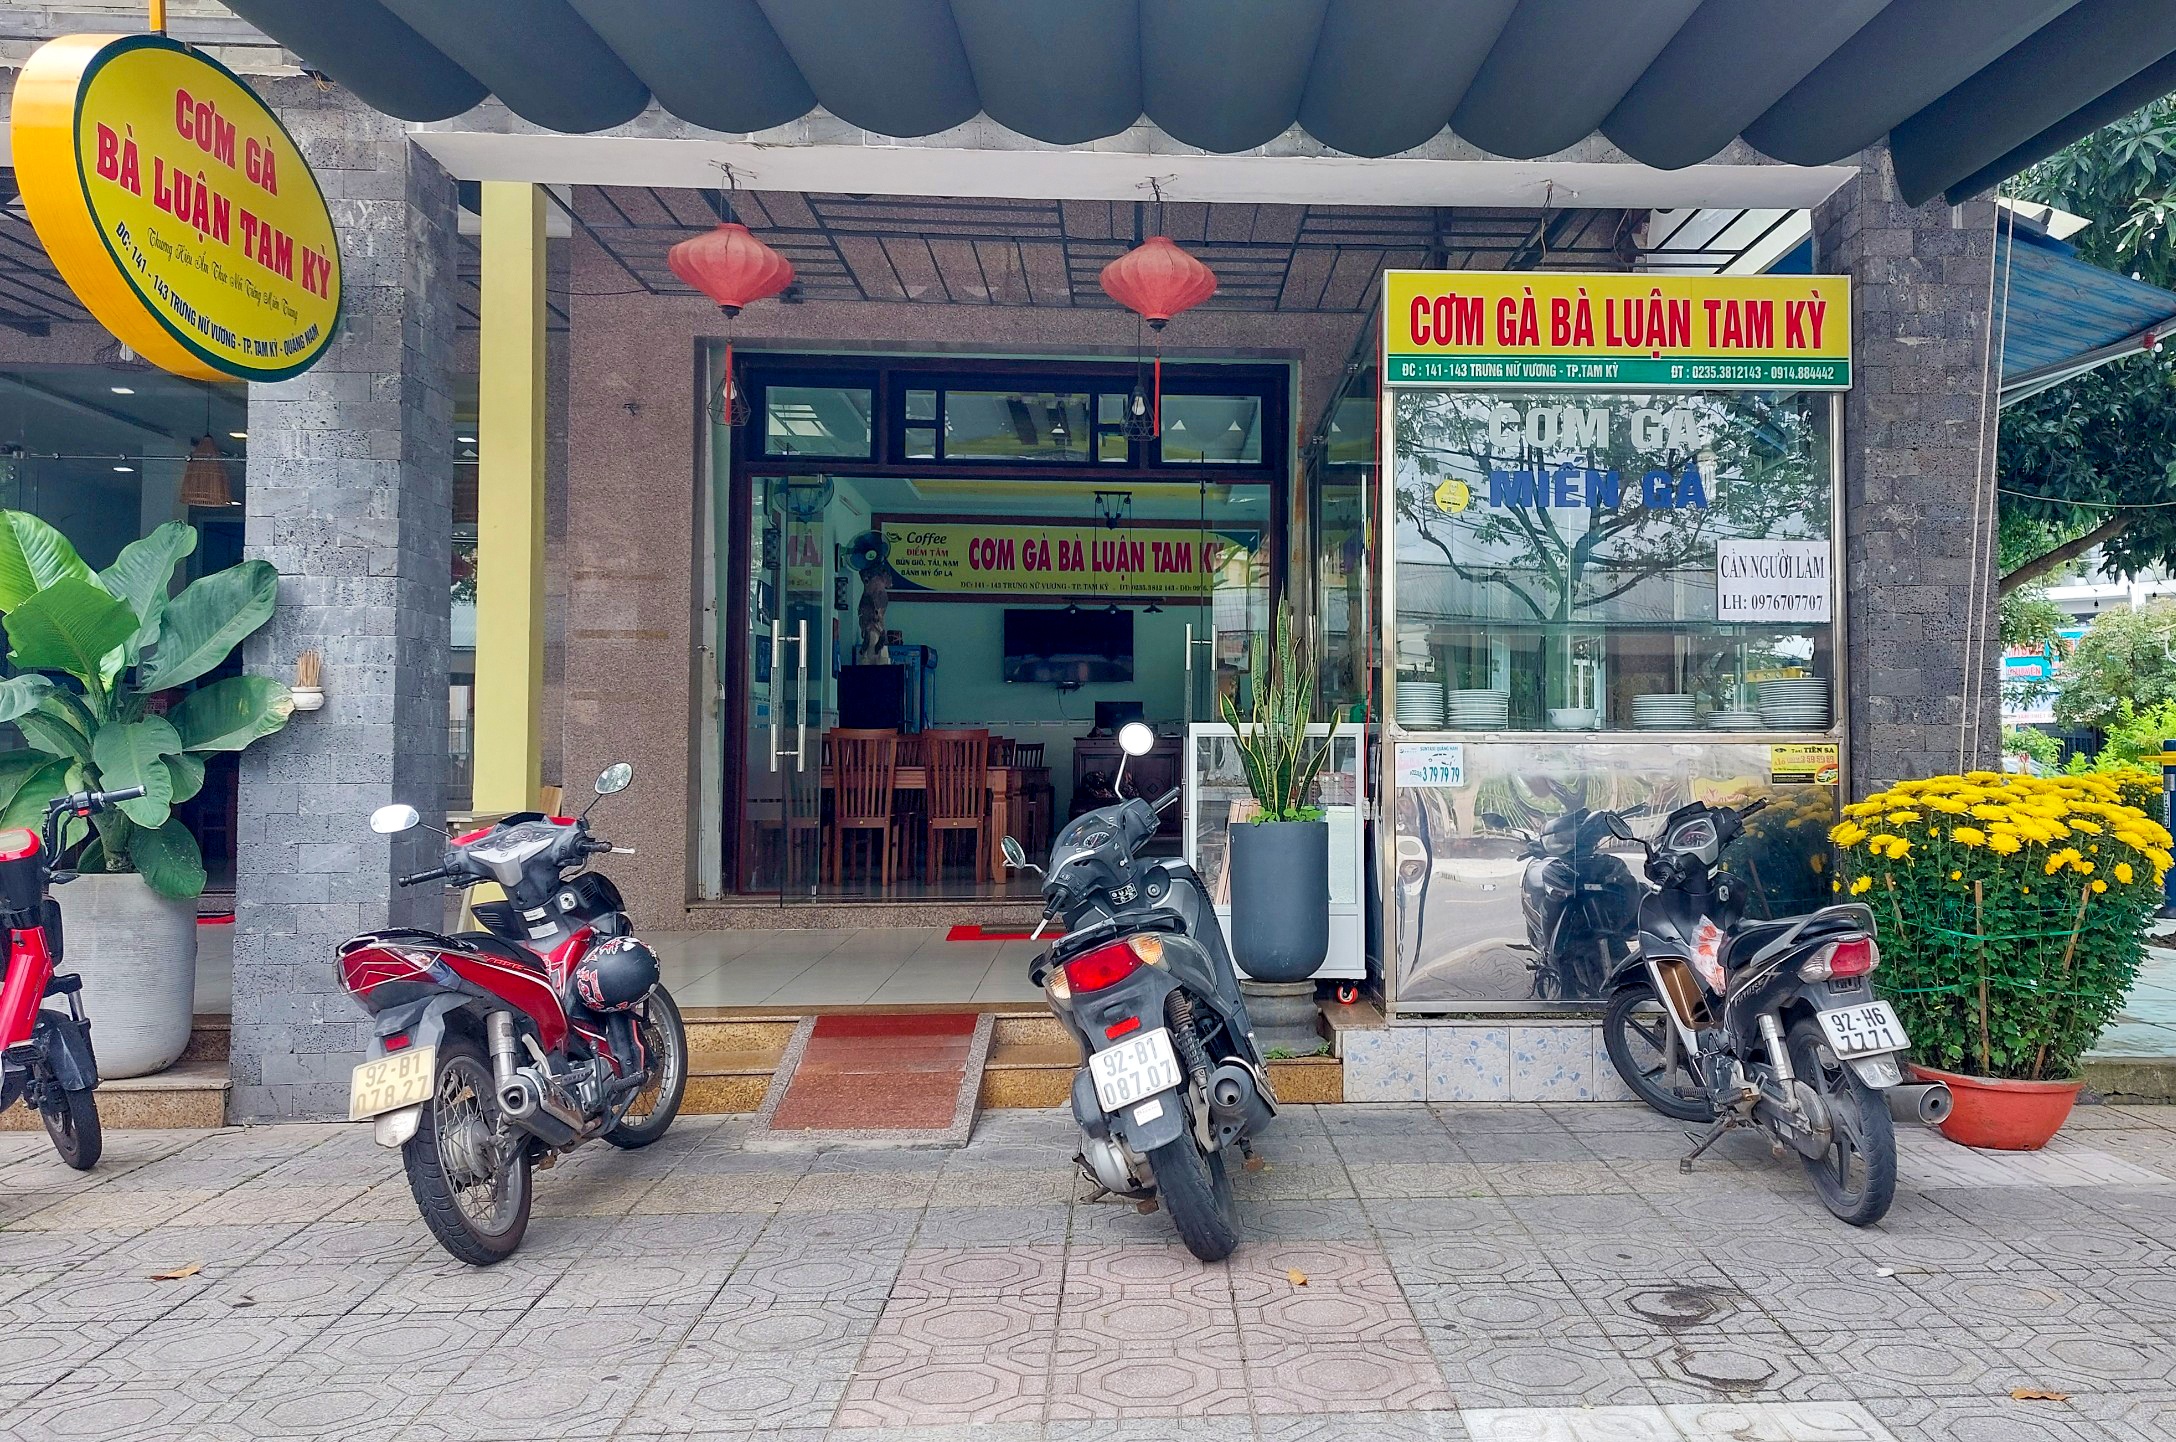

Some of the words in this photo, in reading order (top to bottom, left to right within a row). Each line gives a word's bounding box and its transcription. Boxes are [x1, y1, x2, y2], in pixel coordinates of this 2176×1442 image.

[176, 89, 236, 169] CƠM
[246, 136, 278, 196] GÀ
[97, 122, 141, 196] BÀ
[154, 156, 230, 246] LUẬN
[240, 208, 293, 281] TAM
[302, 244, 331, 300] KỲ
[132, 246, 147, 273] 141
[153, 275, 168, 300] 143
[170, 290, 196, 327] TRƯNG
[211, 323, 236, 349] VƯƠNG
[254, 340, 268, 357] TAM
[305, 323, 319, 346] NAM
[1411, 293, 1484, 346] CƠM
[1497, 287, 1540, 346] GÀ
[1552, 287, 1595, 346] BÀ
[1606, 288, 1690, 359] LUẬN
[1704, 300, 1773, 348] TAM
[1786, 290, 1826, 349] KỲ
[1470, 363, 1503, 377] TRƯNG
[1505, 361, 1520, 377] NỮ
[1523, 363, 1557, 378] VƯƠNG
[1605, 362, 1619, 378] KỲ
[1692, 366, 1761, 379] 0235.3812143
[1771, 367, 1834, 380] 0914.884442
[1488, 404, 1609, 449] CƠM
[1490, 456, 1619, 508] MIẾN
[907, 531, 947, 546] Coffee
[968, 537, 1015, 571] CƠM
[1022, 532, 1051, 572] GÀ
[1058, 534, 1085, 572] BÀ
[1091, 535, 1144, 581] LUẬN
[1152, 542, 1192, 573] TAM
[1721, 548, 1747, 578] CẦN
[1751, 548, 1793, 578] NGƯỜI
[1796, 549, 1825, 578] LÀM
[1722, 595, 1747, 609] LH:
[1752, 595, 1823, 611] 0976707707
[1429, 767, 1438, 782] 79
[1440, 767, 1449, 782] 79
[1451, 767, 1460, 783] 79
[1831, 1007, 1886, 1032] 92-H6
[1103, 1038, 1157, 1076] 92-B1
[1841, 1028, 1896, 1052] 7771
[365, 1053, 420, 1087] 92-B1
[1103, 1059, 1171, 1104] 087.07
[356, 1075, 428, 1111] 078.27
